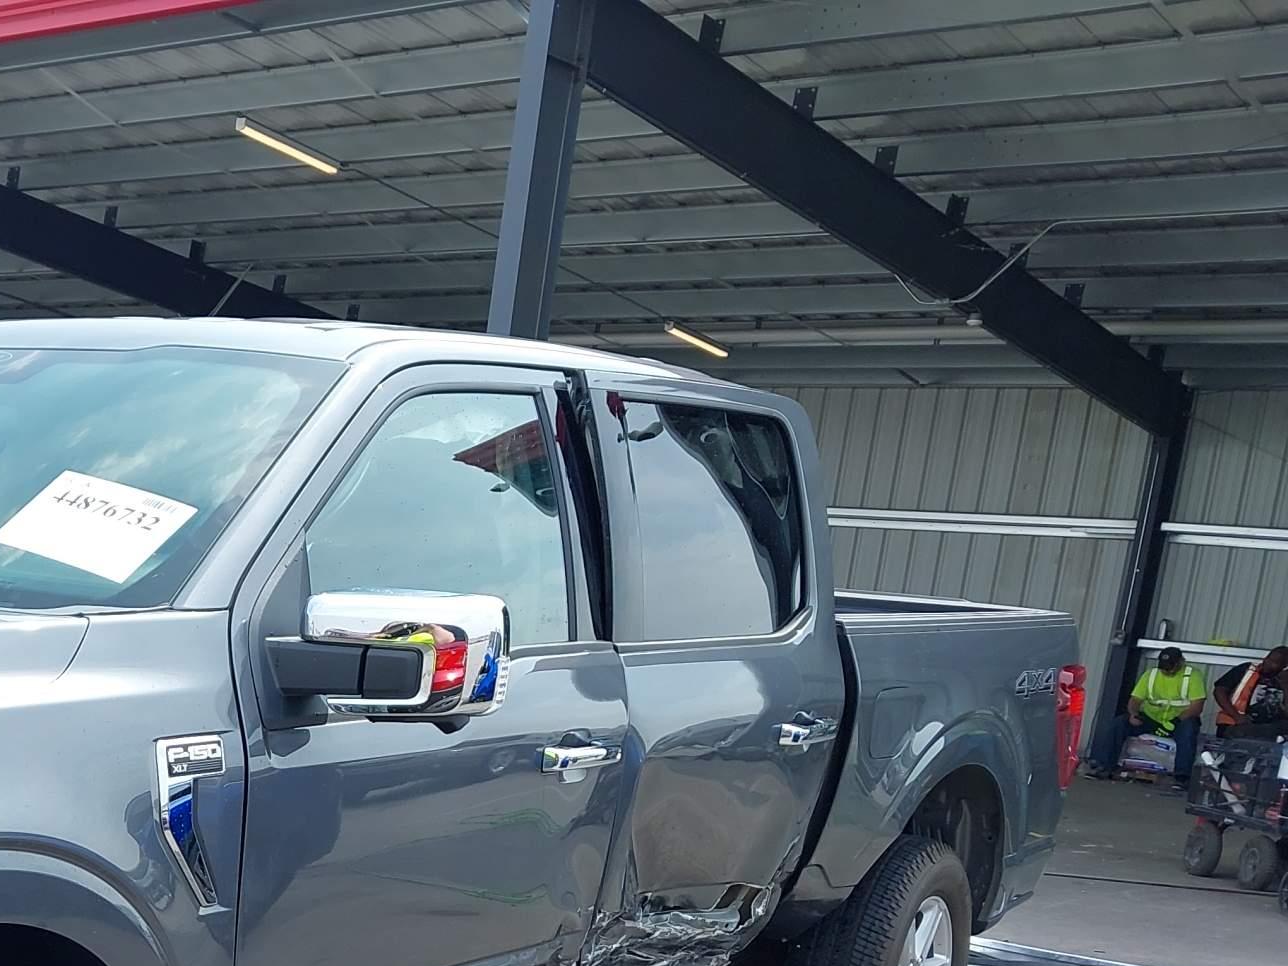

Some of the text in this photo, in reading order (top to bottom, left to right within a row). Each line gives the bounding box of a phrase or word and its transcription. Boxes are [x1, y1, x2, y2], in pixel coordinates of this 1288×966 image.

[52, 490, 161, 531] 44876732
[167, 743, 222, 763] F-150
[171, 763, 188, 774] XLT
